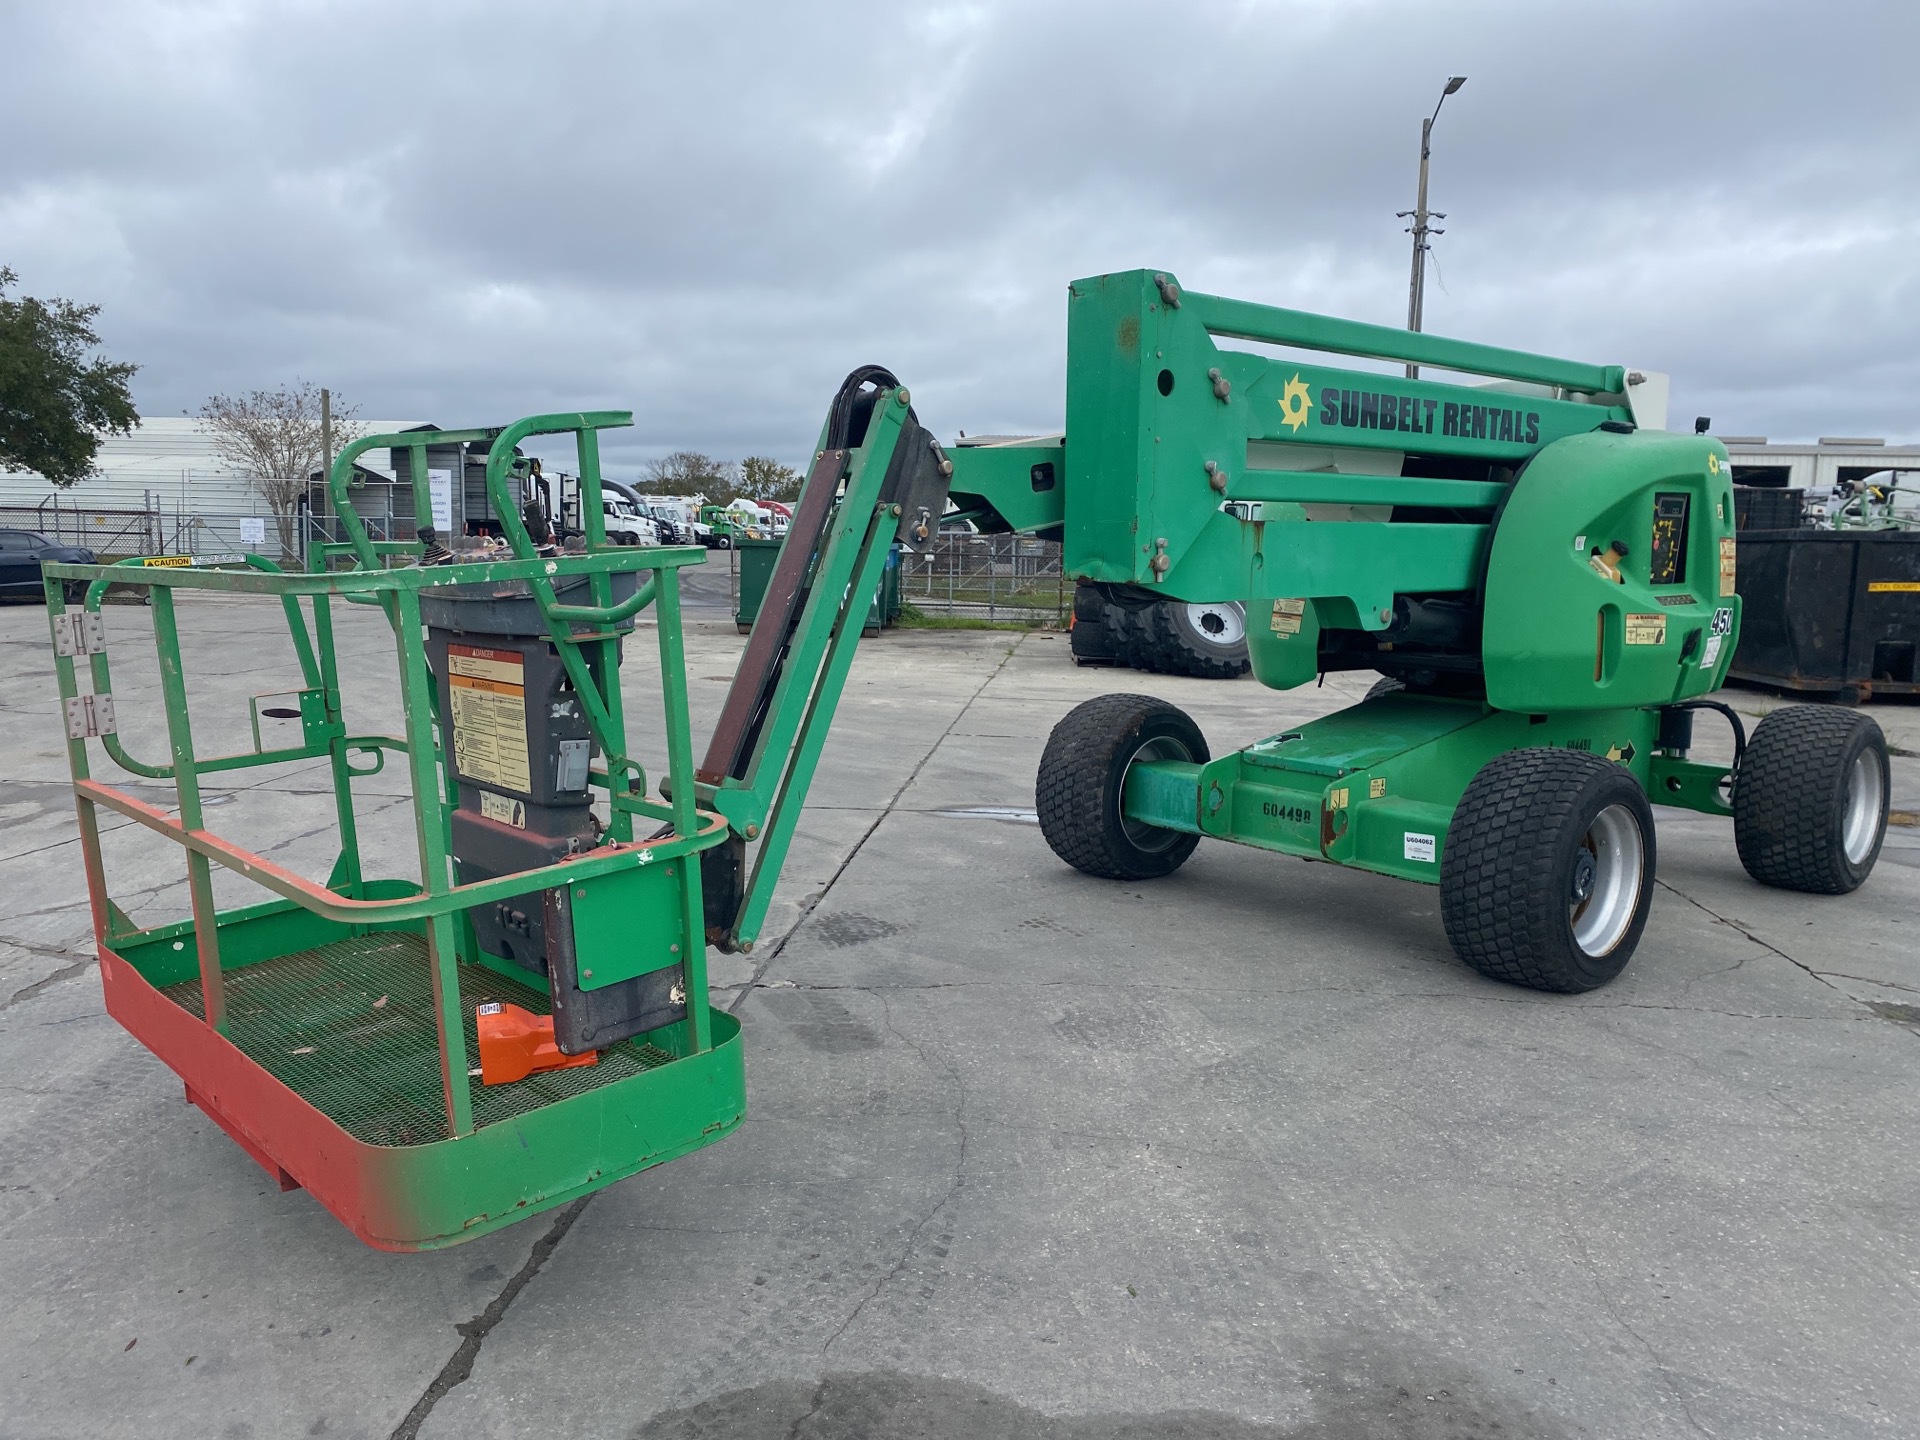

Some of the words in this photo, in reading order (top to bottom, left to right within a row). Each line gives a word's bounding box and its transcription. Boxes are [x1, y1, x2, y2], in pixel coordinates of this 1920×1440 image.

[1320, 388, 1437, 434] SUNBELT
[1443, 402, 1539, 444] RENTALS
[153, 558, 189, 567] CAUTION
[475, 649, 494, 659] DANGER
[475, 681, 495, 692] WARNING
[1263, 802, 1311, 824] 604498
